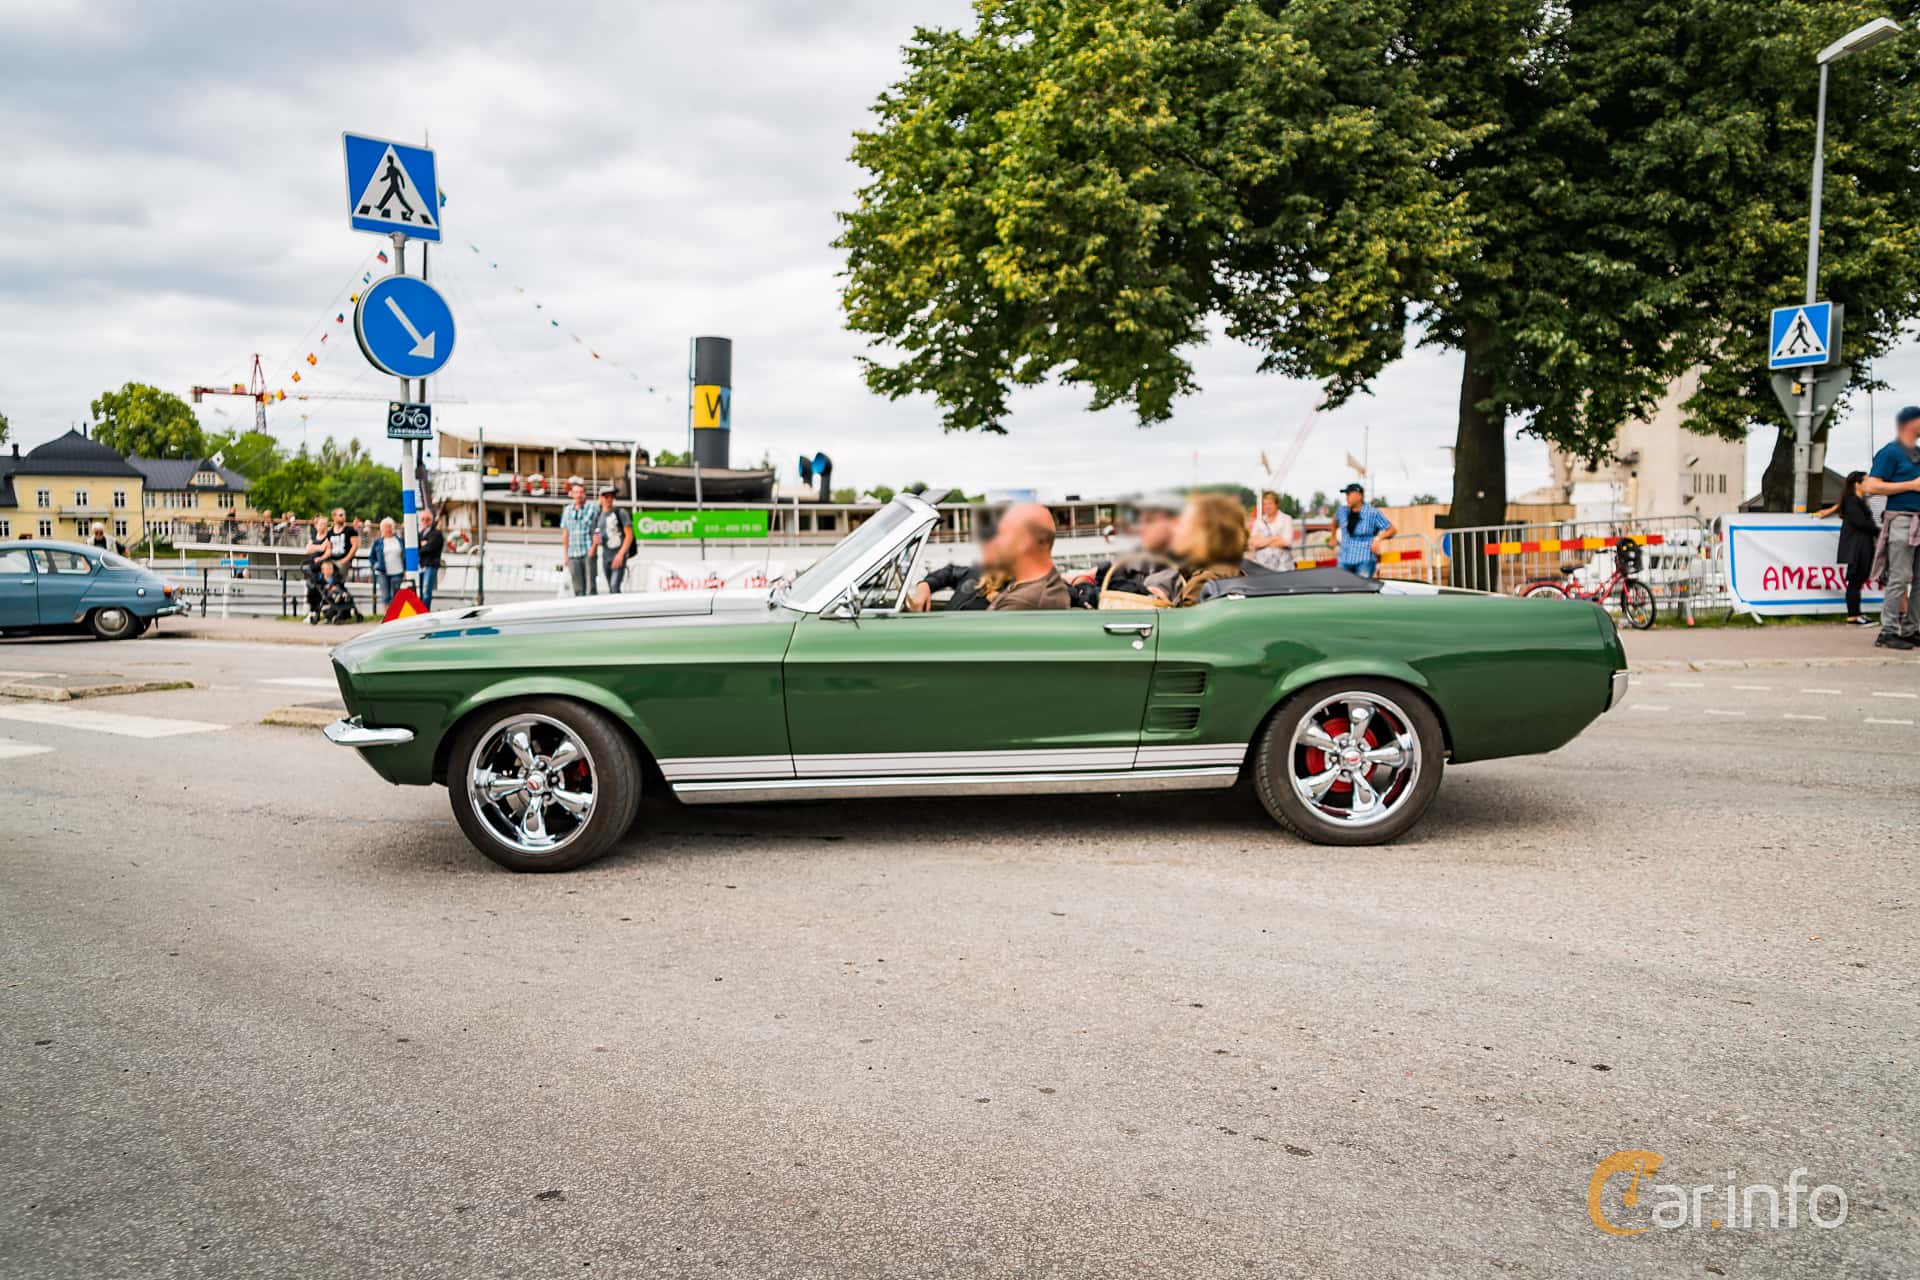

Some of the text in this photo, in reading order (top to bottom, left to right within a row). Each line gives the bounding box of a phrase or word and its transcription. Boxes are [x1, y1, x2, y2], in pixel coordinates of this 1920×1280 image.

[705, 391, 731, 422] W
[637, 516, 694, 534] Green
[1762, 565, 1883, 591] AMERI
